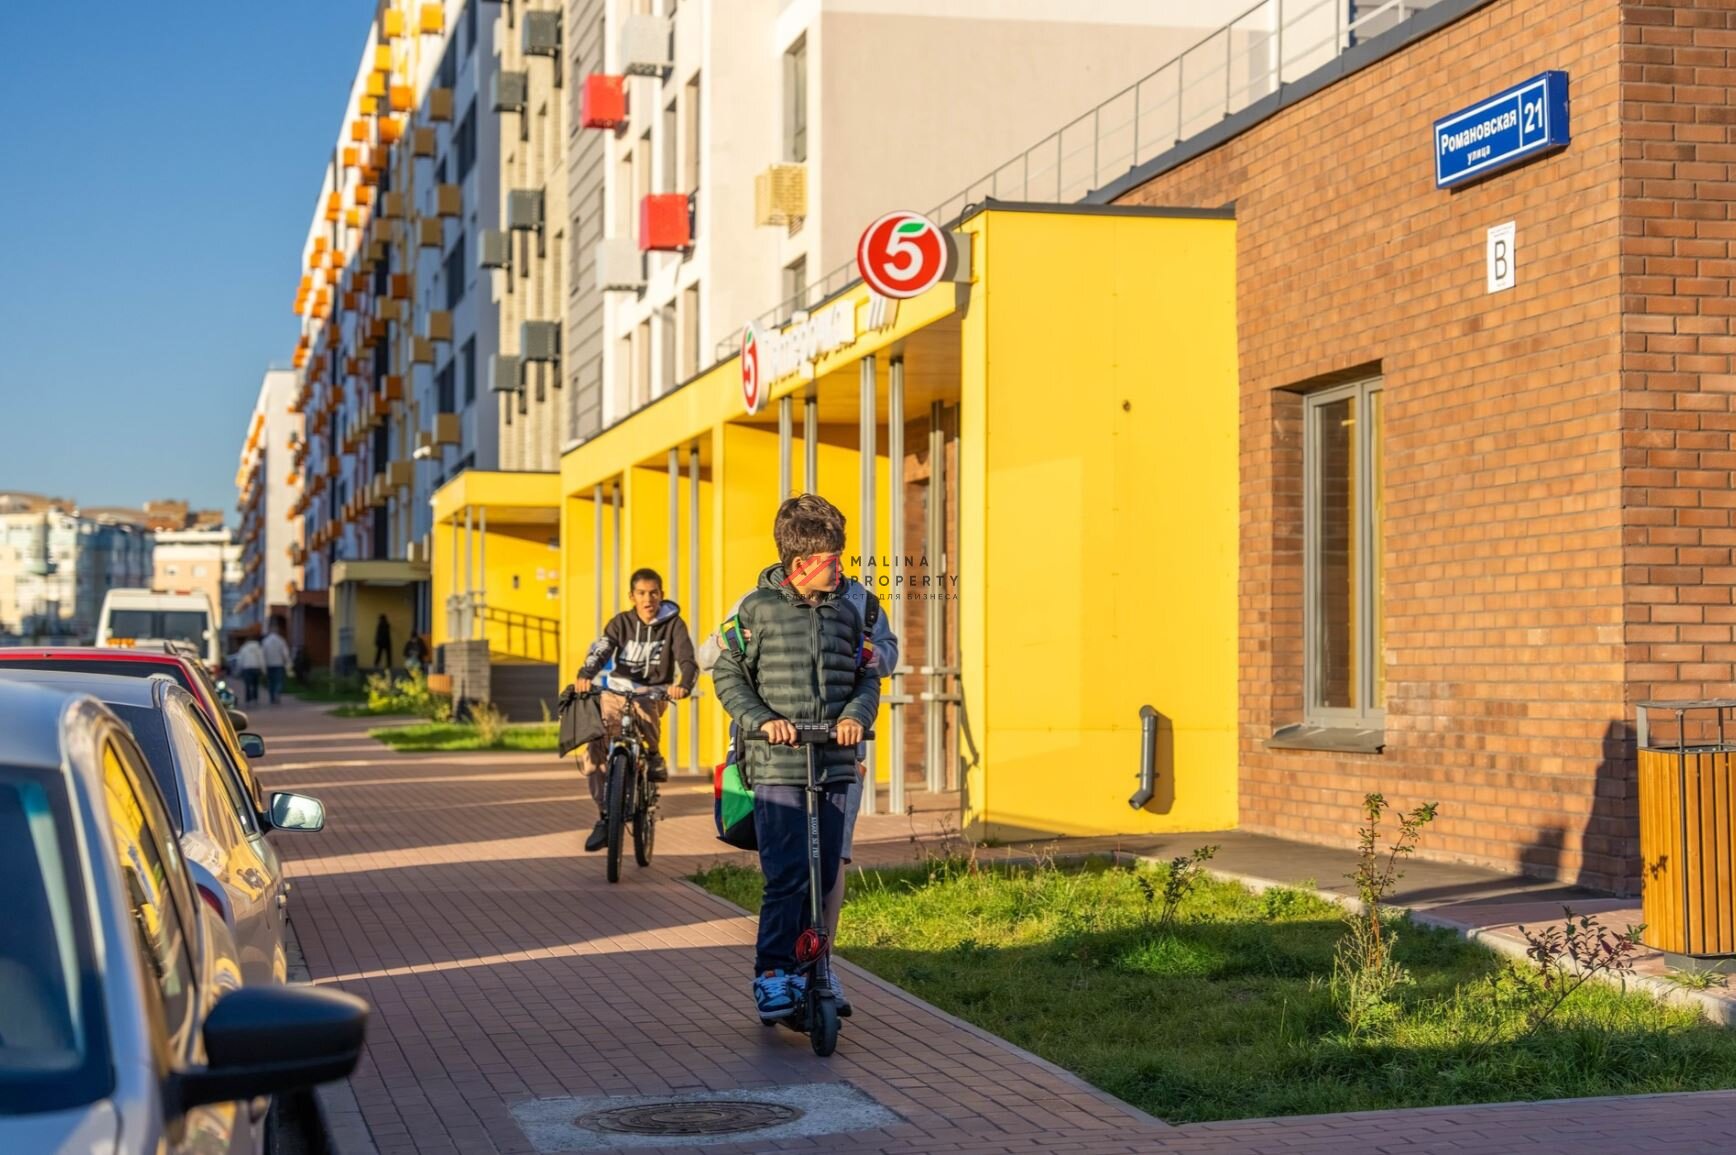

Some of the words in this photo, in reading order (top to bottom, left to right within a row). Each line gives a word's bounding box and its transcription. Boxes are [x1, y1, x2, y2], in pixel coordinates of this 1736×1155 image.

[1441, 109, 1517, 155] Романовская
[1524, 97, 1543, 134] 21
[1467, 145, 1491, 166] улица
[883, 217, 931, 281] 5
[744, 327, 757, 398] 5
